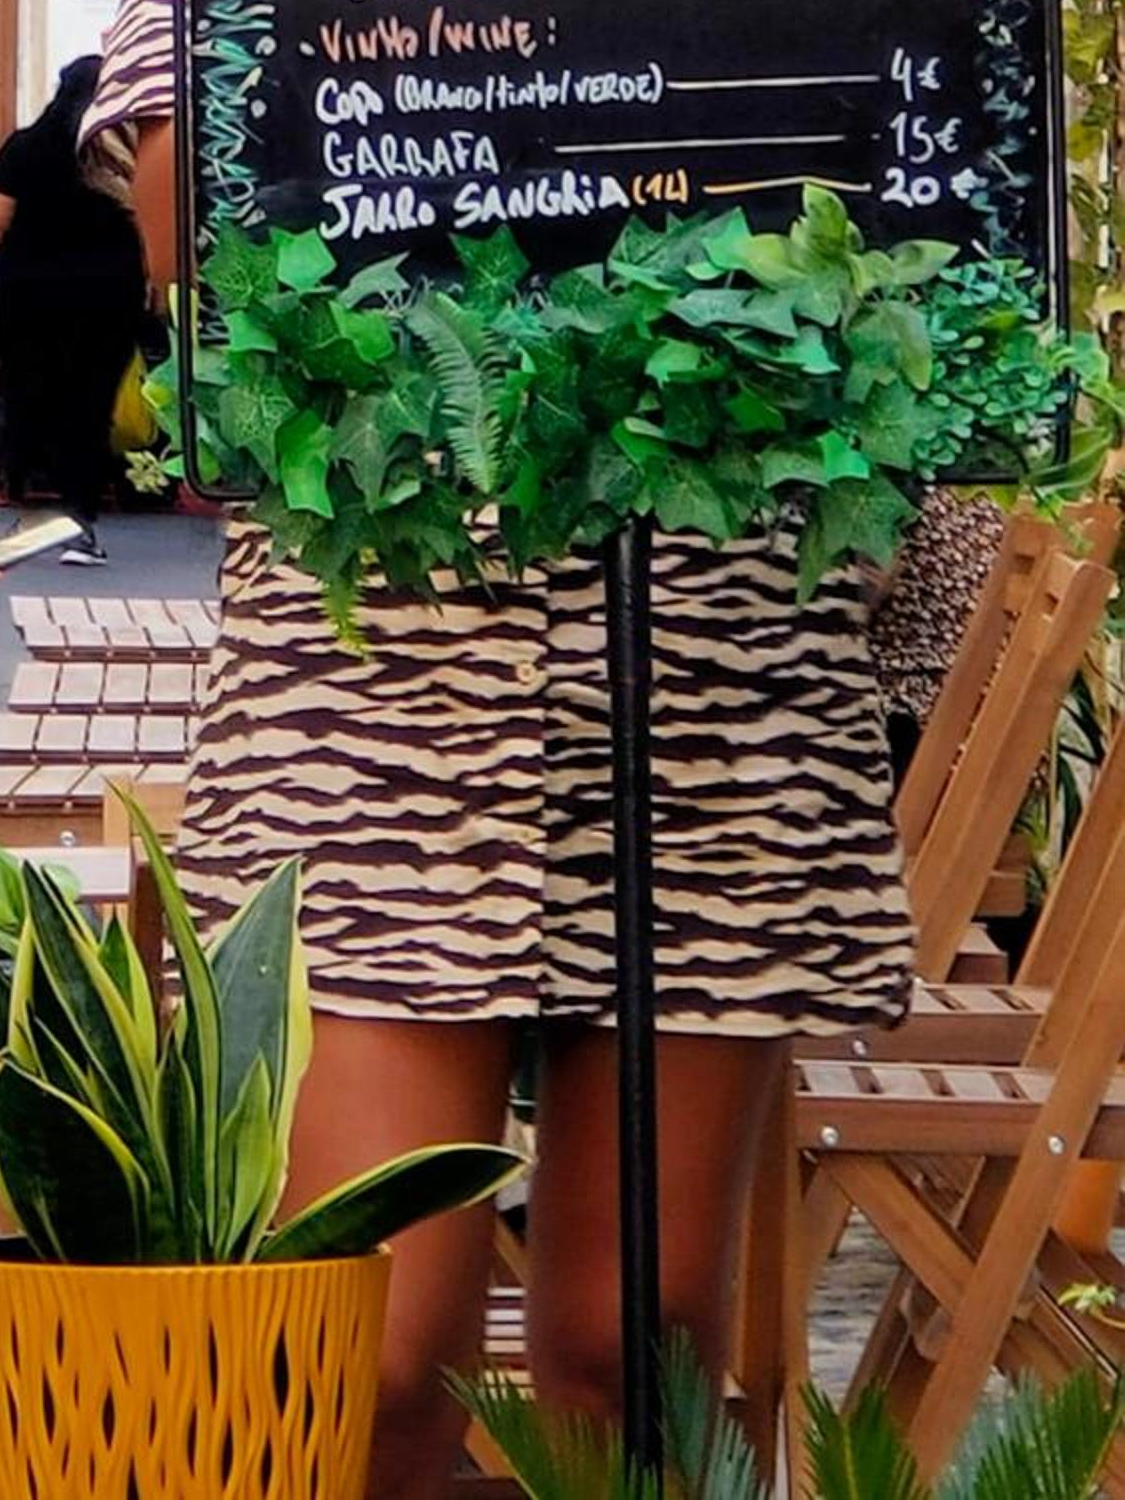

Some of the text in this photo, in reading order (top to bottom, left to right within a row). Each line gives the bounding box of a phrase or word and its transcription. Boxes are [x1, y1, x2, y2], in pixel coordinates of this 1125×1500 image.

[890, 47, 942, 102] 4€
[325, 111, 963, 181] GARRAFA 15€
[452, 169, 630, 230] SANGRIA
